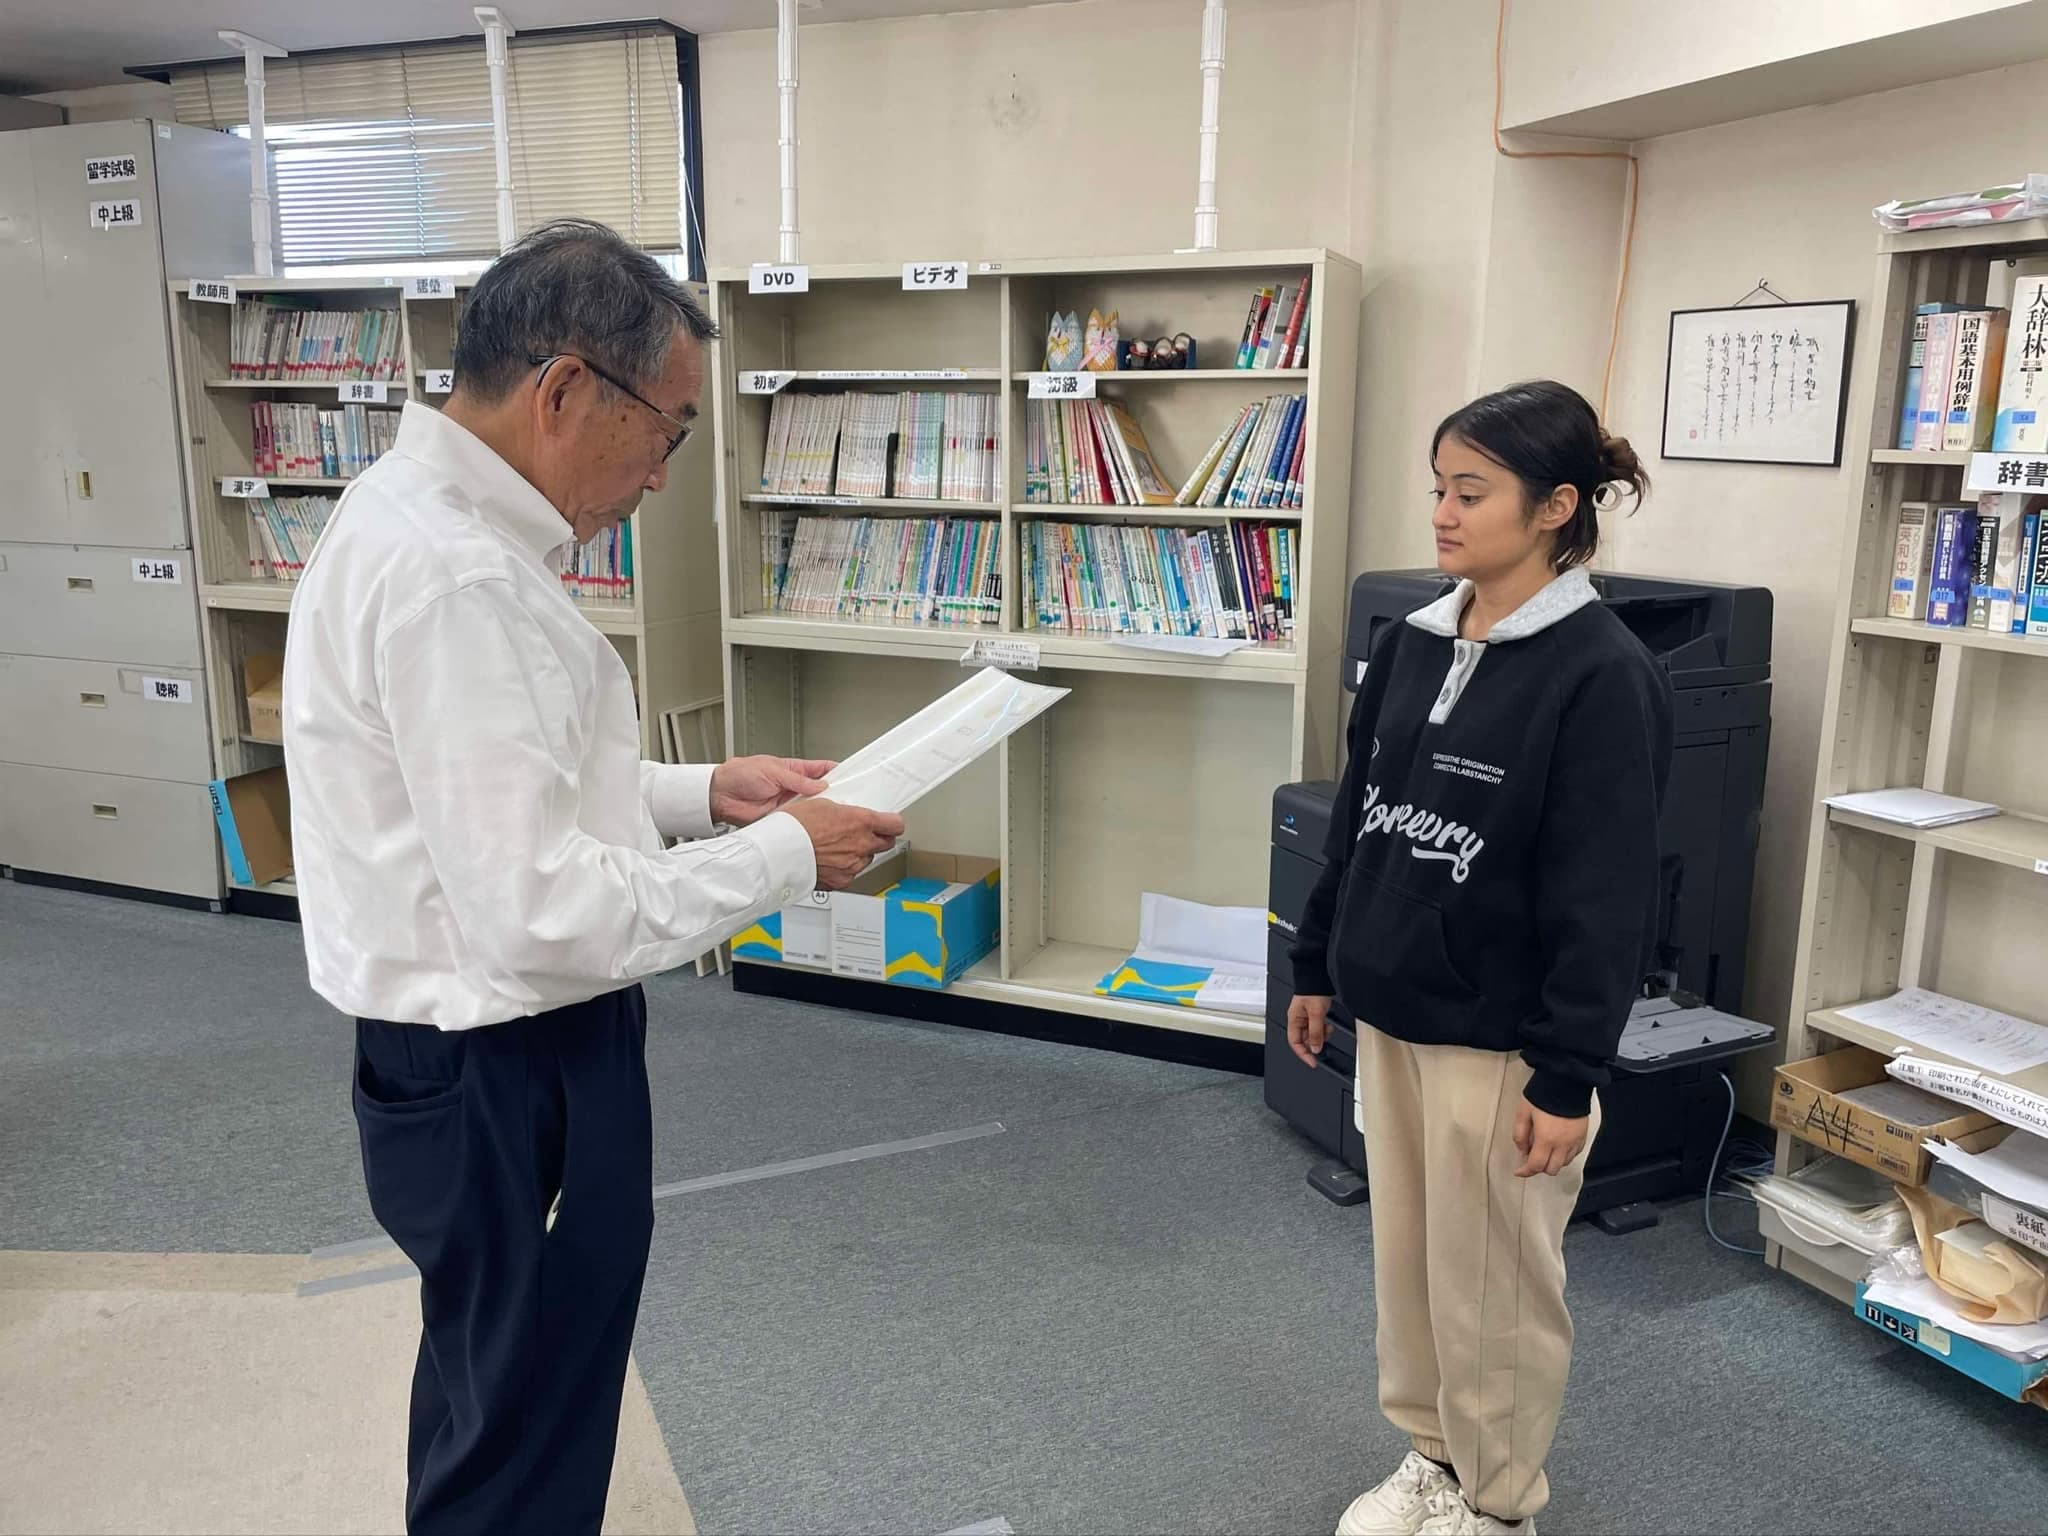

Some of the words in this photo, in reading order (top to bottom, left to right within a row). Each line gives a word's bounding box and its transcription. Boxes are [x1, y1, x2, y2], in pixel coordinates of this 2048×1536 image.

[87, 158, 136, 180] 留学試験
[98, 204, 134, 222] 中上級
[763, 272, 794, 286] DVD
[913, 266, 958, 284] ビデオ
[195, 282, 229, 299] 教師用
[2022, 284, 2048, 359] 大辞林
[351, 385, 374, 399] 辞書
[1997, 460, 2048, 487] 辞書
[233, 480, 254, 494] 漢字
[139, 562, 174, 580] 中上級
[155, 682, 179, 699] 聴解
[1461, 758, 1505, 776] ORIGINATION
[1805, 1094, 1852, 1152] A4
